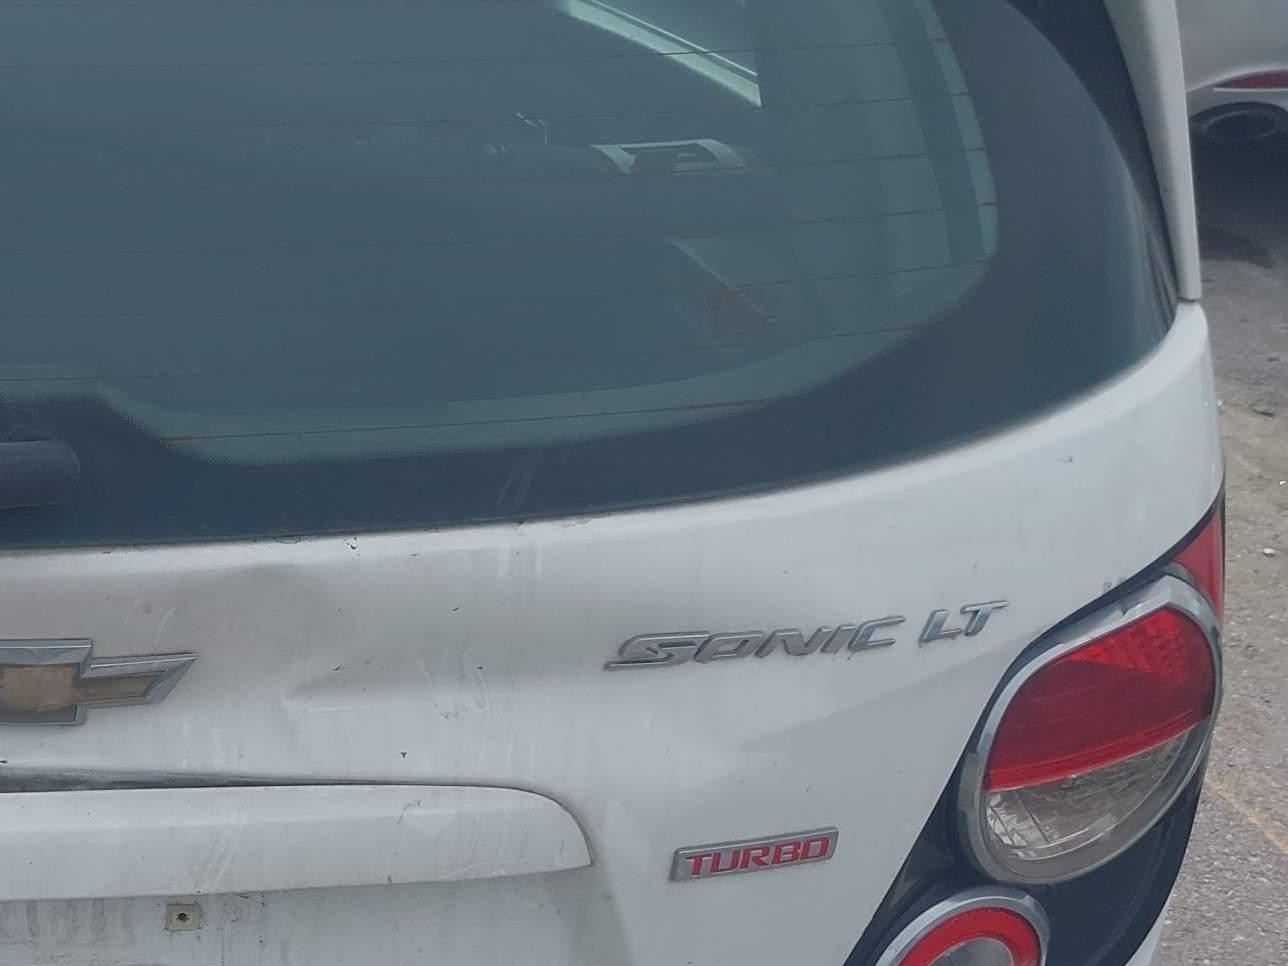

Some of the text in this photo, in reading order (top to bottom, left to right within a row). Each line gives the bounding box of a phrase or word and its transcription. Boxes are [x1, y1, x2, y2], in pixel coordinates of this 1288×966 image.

[604, 600, 1009, 672] SONIC LT
[685, 835, 831, 879] TURBO
